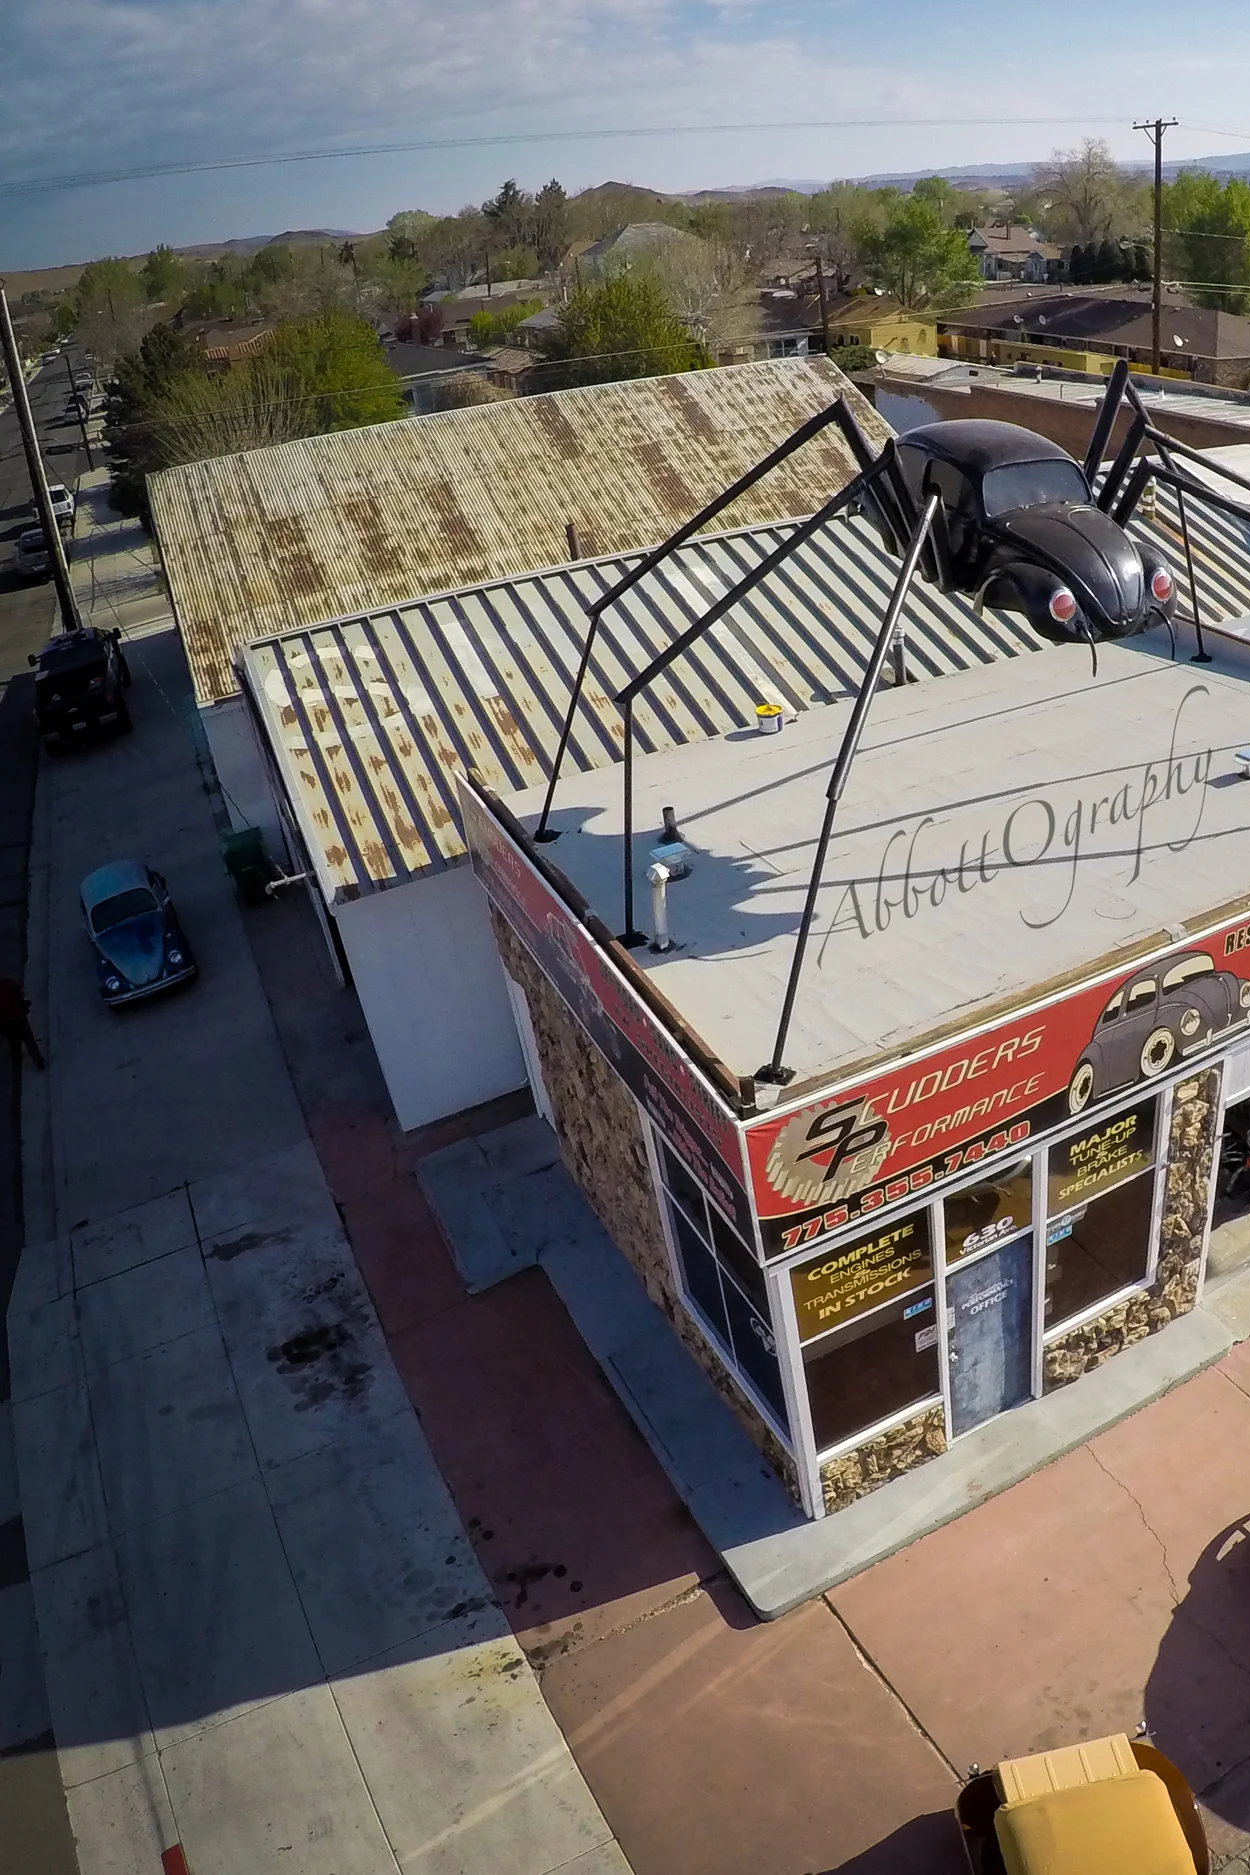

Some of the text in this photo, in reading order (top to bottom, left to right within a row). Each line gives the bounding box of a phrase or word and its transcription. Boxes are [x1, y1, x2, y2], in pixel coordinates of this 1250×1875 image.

[1069, 1114, 1138, 1157] MAJOR
[1069, 1126, 1137, 1166] TUNE-UP
[1058, 1148, 1144, 1200] SPECIALISTS
[1076, 1143, 1128, 1178] BRAKE
[781, 1119, 1031, 1251] 775.355.7440
[807, 1223, 914, 1281] COMPLETE
[962, 1215, 1014, 1248] 630
[803, 1248, 922, 1310] TRANSMISSIONS
[830, 1246, 895, 1285] ENGINES
[818, 1266, 912, 1320] IN STOCK
[969, 1289, 1008, 1316] OFFICE
